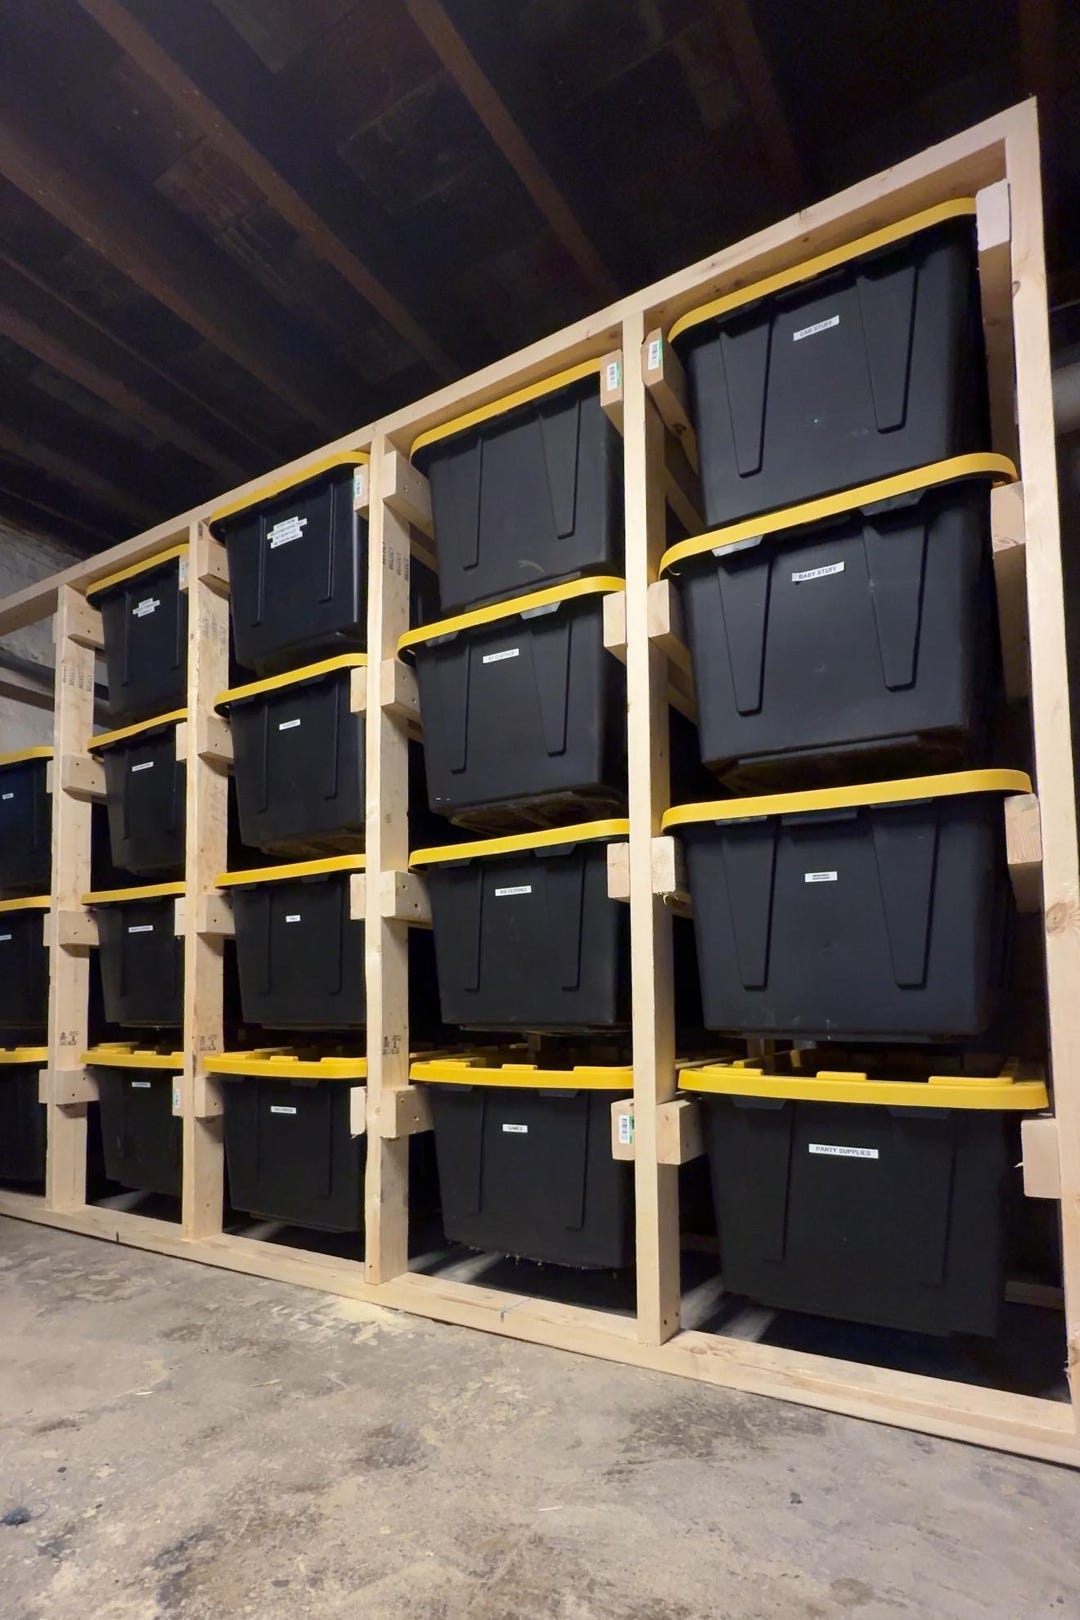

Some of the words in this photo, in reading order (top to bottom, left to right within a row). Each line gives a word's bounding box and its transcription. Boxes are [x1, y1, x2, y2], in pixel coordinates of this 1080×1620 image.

[814, 320, 833, 331] STUFF
[798, 570, 816, 580] BABY
[817, 566, 837, 576] STUFF
[839, 1148, 872, 1156] SUPPLIES
